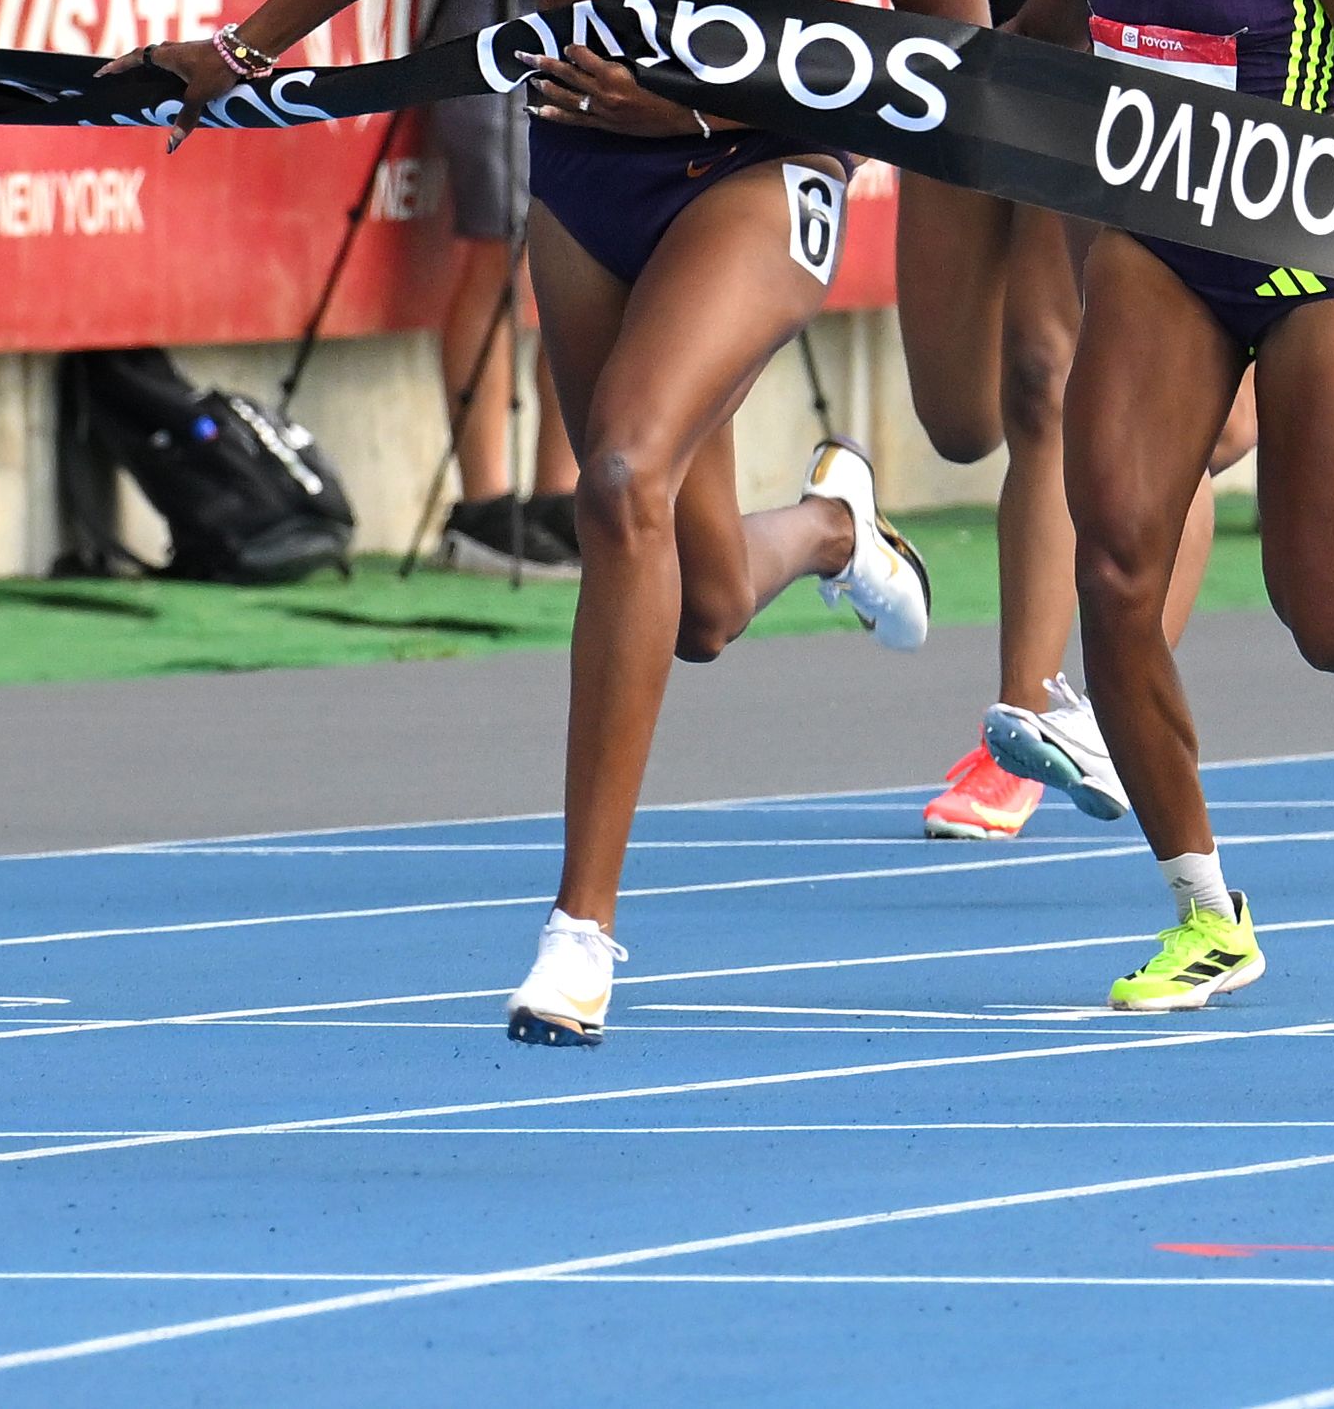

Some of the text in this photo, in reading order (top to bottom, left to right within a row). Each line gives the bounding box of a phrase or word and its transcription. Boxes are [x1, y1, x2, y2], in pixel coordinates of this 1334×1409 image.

[1140, 35, 1184, 52] TOYOTA
[55, 166, 148, 237] YORK
[797, 176, 833, 268] 6
